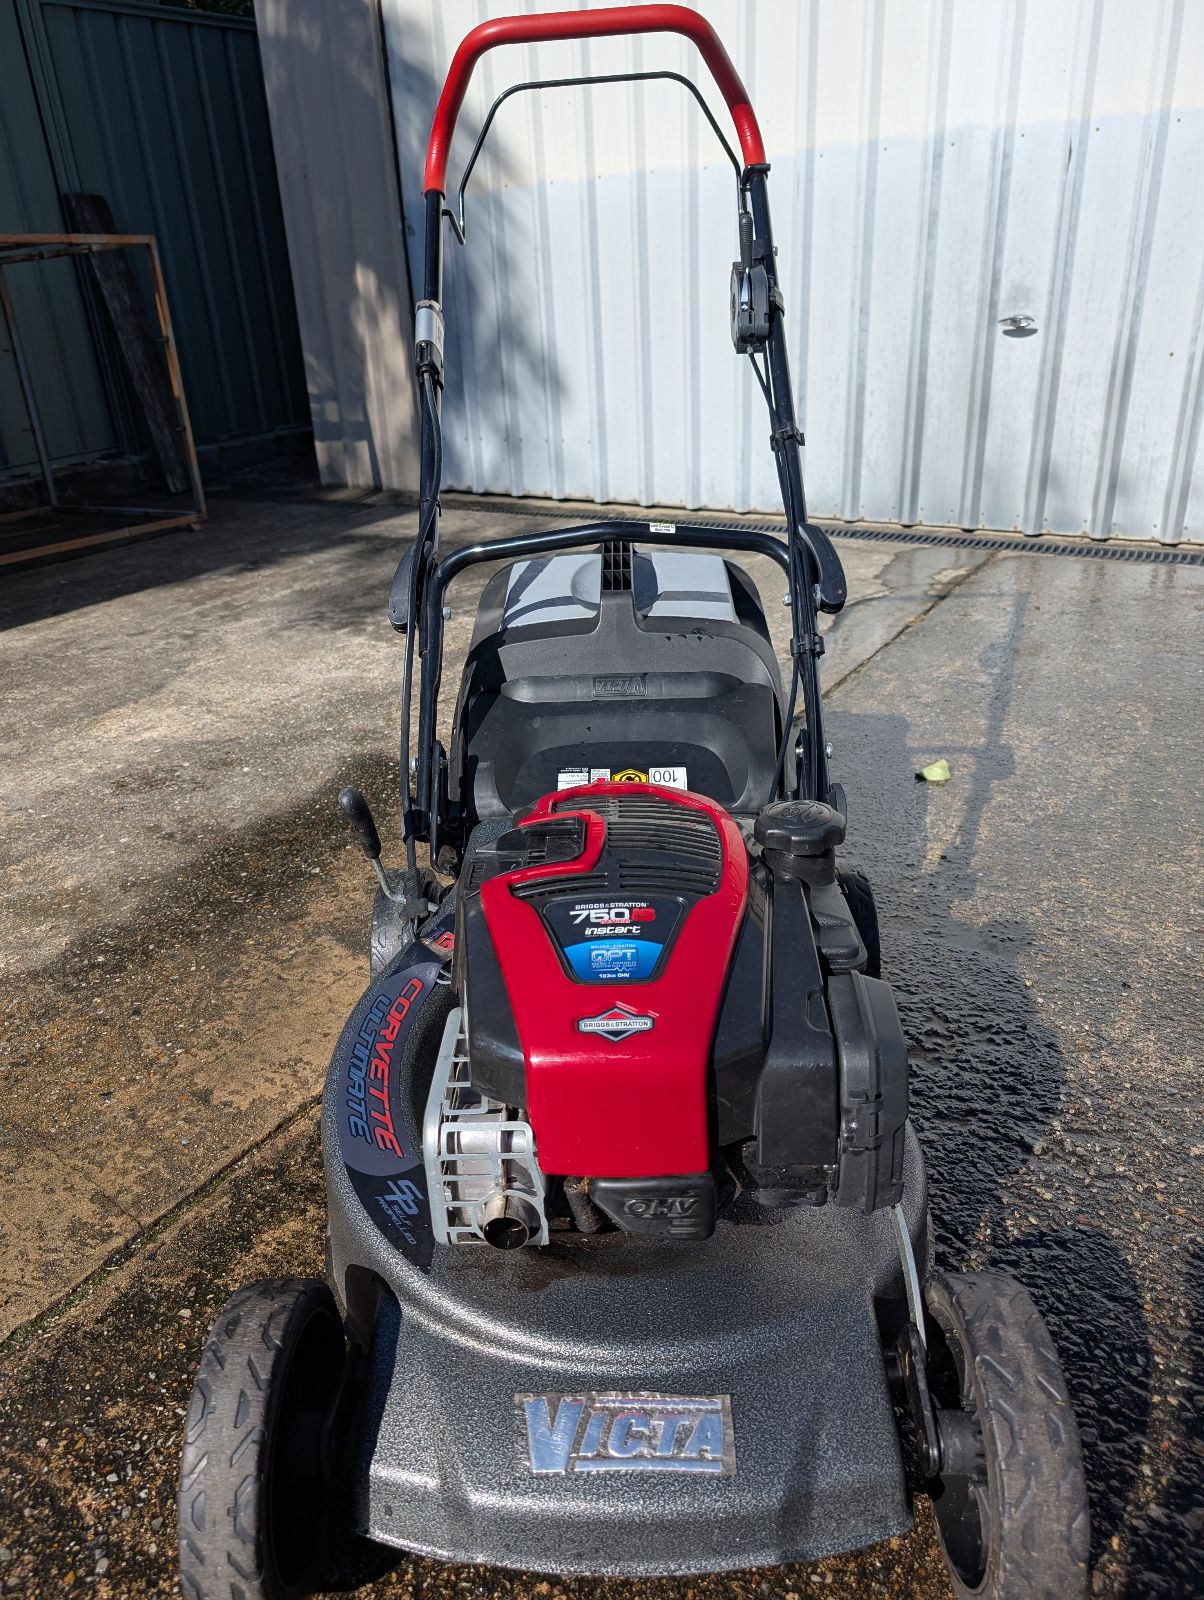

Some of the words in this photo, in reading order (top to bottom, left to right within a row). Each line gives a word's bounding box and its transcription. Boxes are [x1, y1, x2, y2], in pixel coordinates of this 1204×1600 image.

[653, 769, 678, 783] 100
[346, 993, 392, 1144] ULTIMATE
[368, 977, 424, 1159] CORVETTE
[374, 1196, 417, 1245] PROPELLED
[391, 1204, 414, 1227] SELF
[624, 1198, 699, 1217] OHV
[523, 1396, 724, 1474] VICTA
